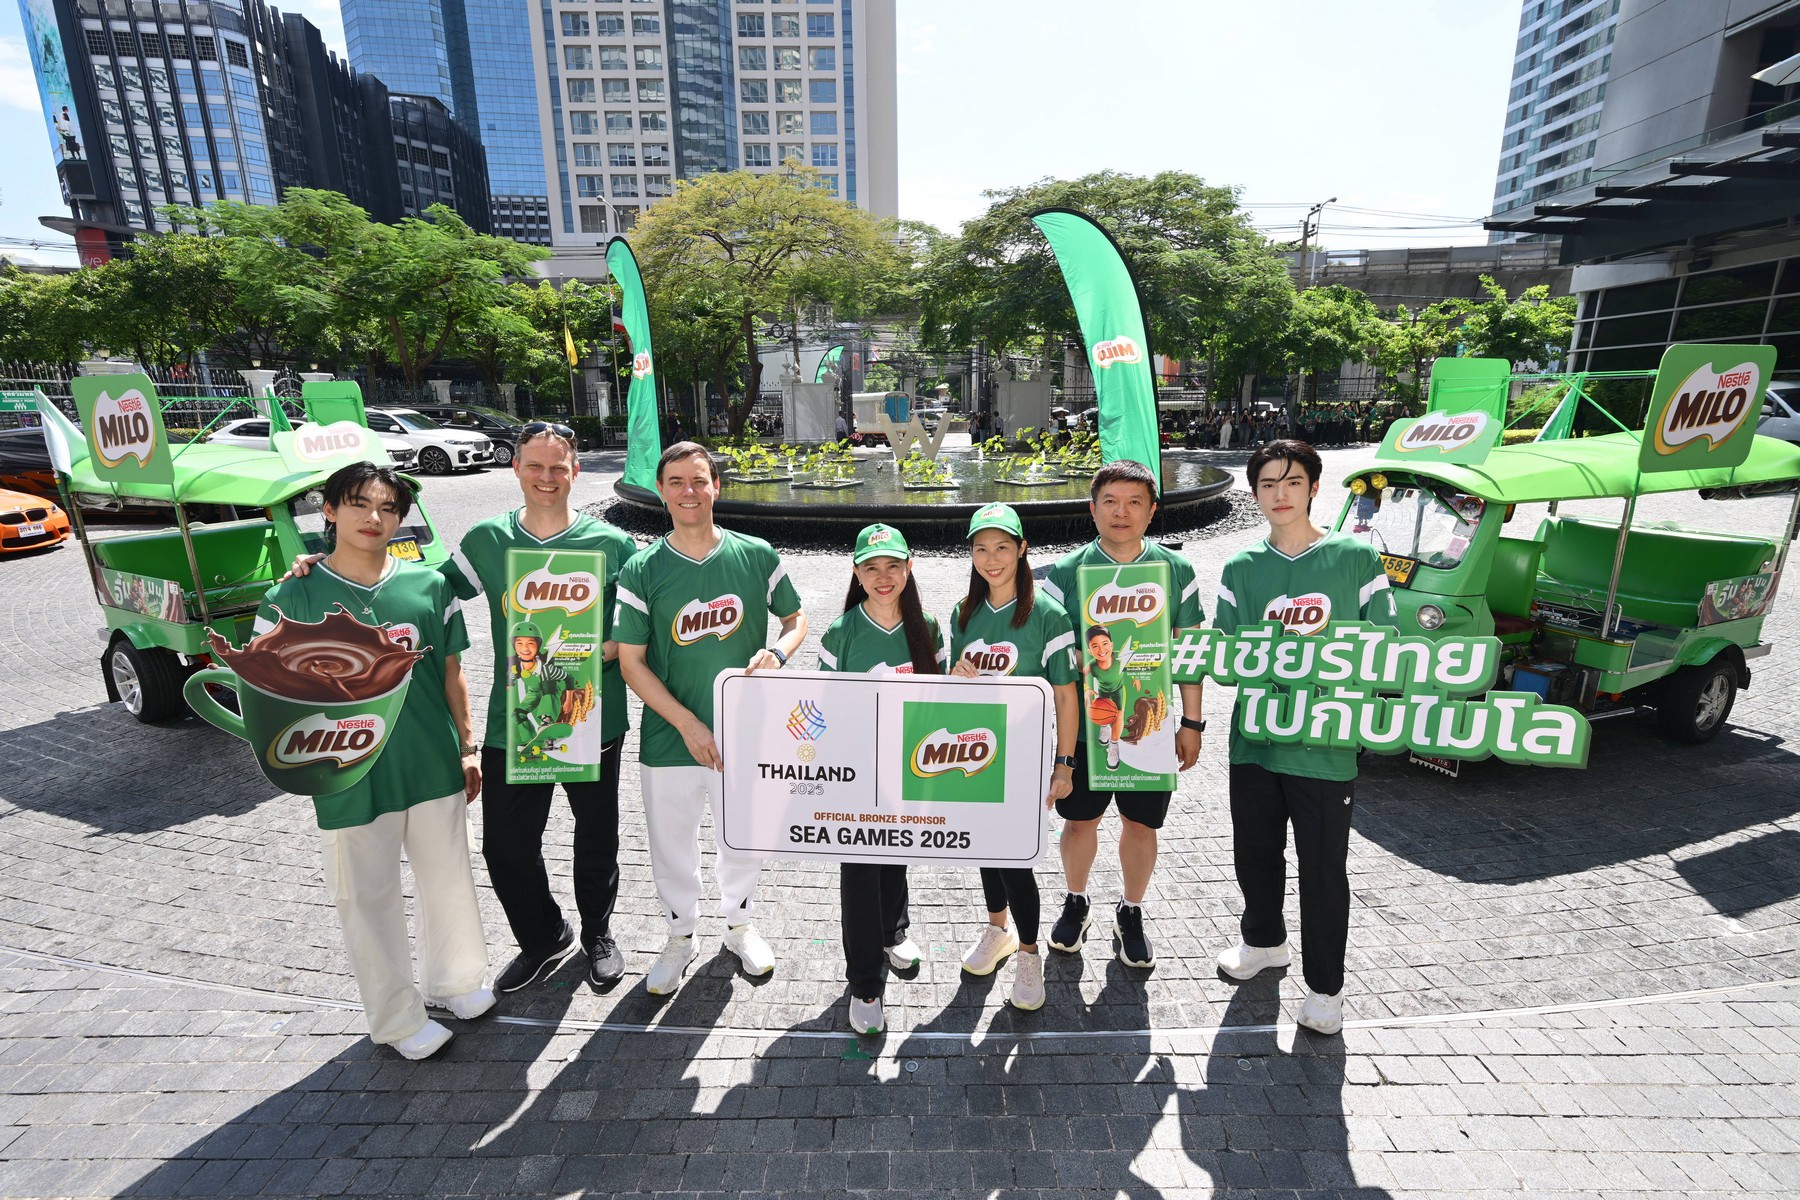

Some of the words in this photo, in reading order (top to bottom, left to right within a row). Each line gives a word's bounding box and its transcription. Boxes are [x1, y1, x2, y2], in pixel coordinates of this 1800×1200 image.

[1668, 388, 1747, 432] MILO
[98, 411, 149, 449] MILO
[1406, 424, 1475, 442] MILO
[303, 433, 360, 454] MILO
[524, 581, 590, 602] MILO
[1096, 594, 1156, 614] MILO
[680, 606, 737, 634] MILO
[388, 628, 411, 638] estlé
[1172, 626, 1487, 684] #เชียร์ไทย
[1242, 687, 1577, 755] ไปกับไมโล
[284, 729, 375, 755] MILO
[922, 742, 989, 765] MILO
[758, 763, 856, 782] THAILAND
[789, 782, 825, 795] 2025
[814, 812, 856, 822] OFFICIAL
[859, 814, 897, 823] BRONZE
[900, 816, 946, 825] SPONSOR
[789, 825, 831, 844] SEA
[837, 827, 913, 847] GAMES
[920, 830, 971, 849] 2025
